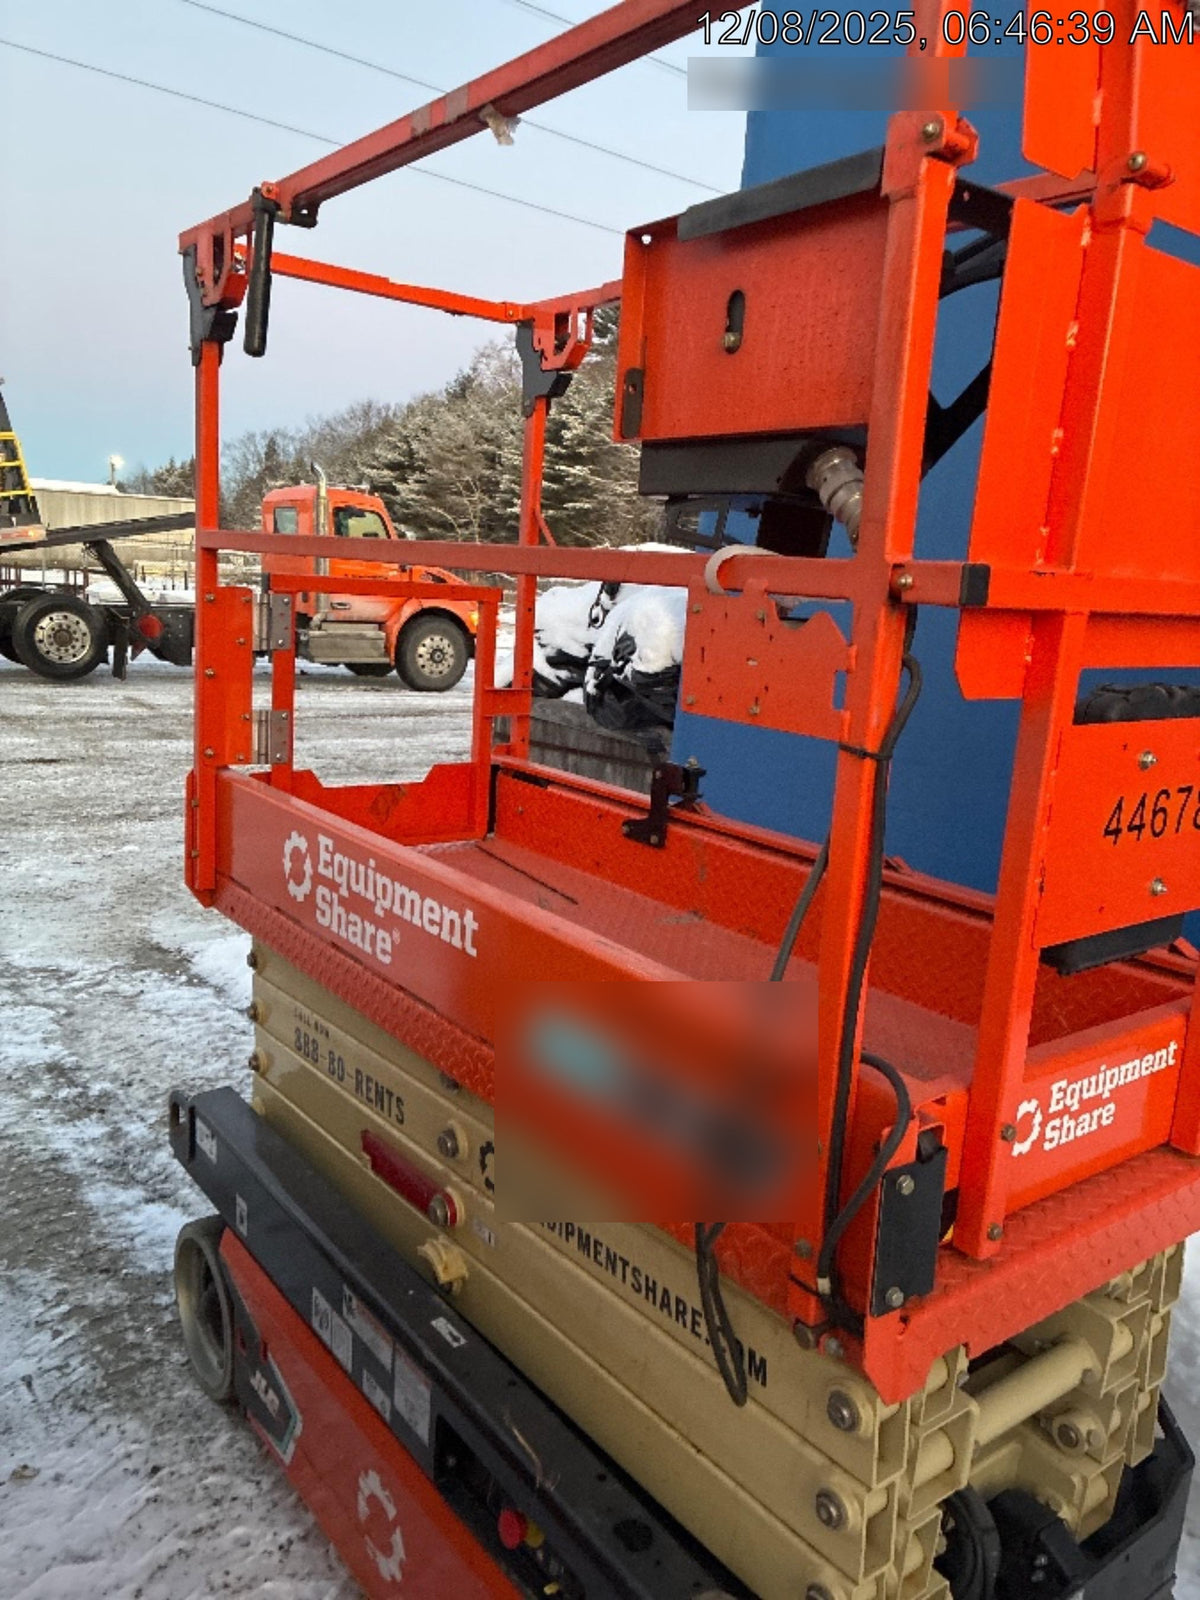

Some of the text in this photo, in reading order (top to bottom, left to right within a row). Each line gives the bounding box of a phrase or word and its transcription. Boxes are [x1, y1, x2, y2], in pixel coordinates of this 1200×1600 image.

[317, 833, 479, 957] Equipment
[1048, 1040, 1178, 1114] Equipment
[1043, 1102, 1116, 1151] Share
